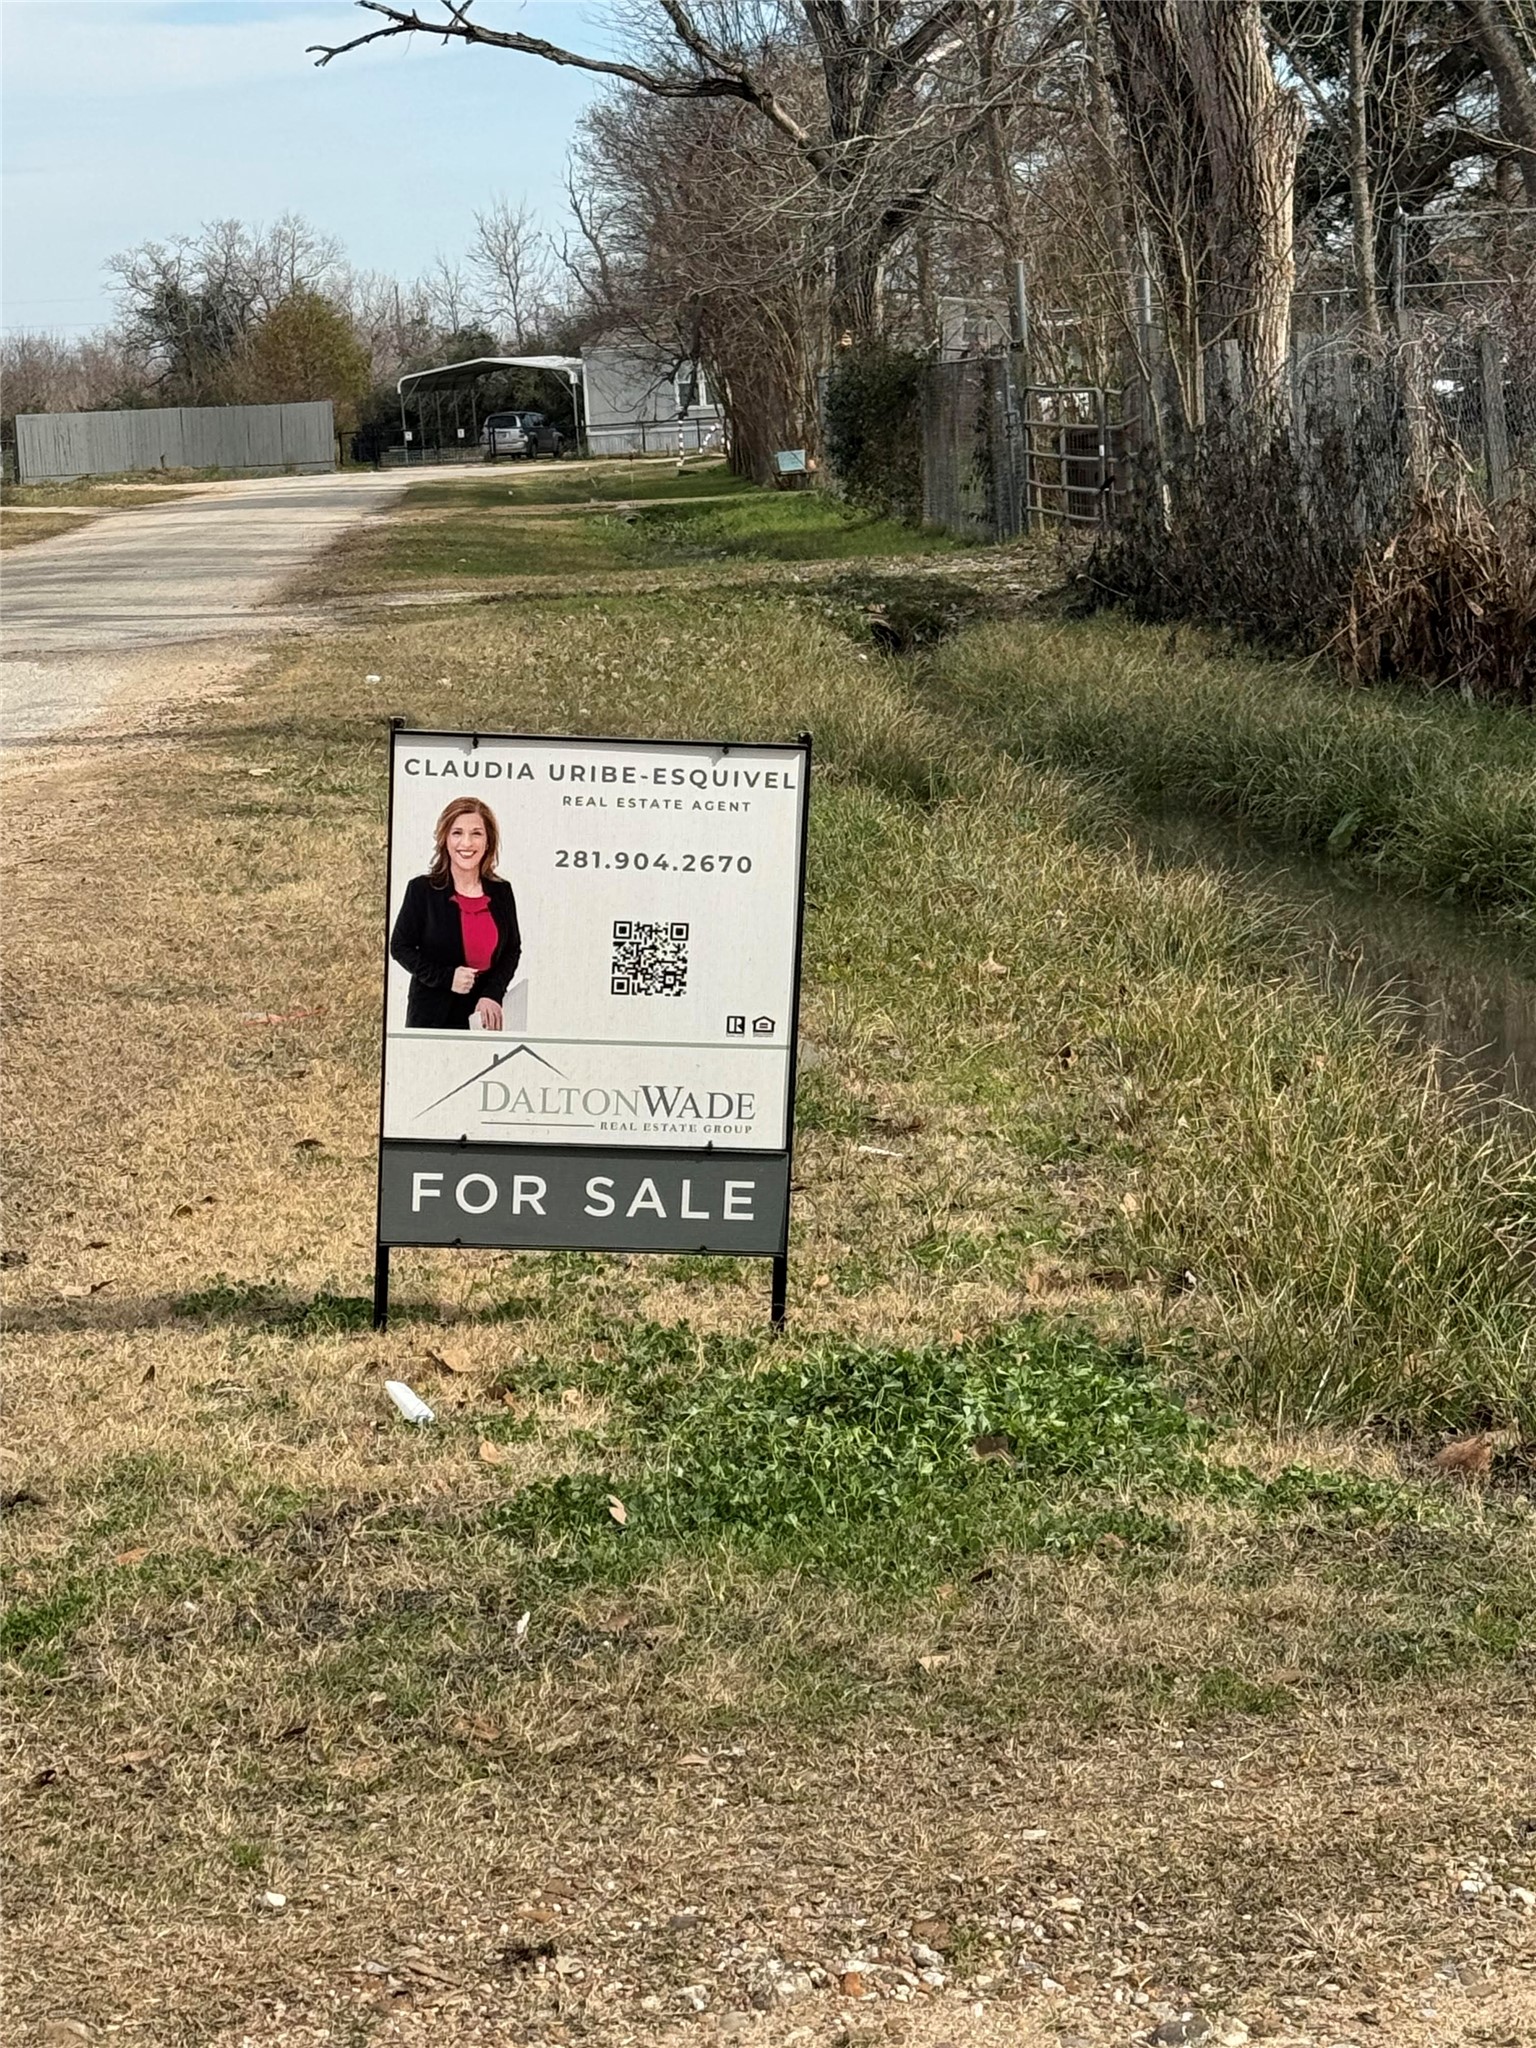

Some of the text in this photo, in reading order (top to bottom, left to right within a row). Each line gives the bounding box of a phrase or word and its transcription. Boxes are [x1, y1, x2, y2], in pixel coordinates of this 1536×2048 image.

[404, 758, 796, 790] CLAUDIA URIBE-ESQUIVEL
[562, 795, 751, 812] REAL ESTATE AGENT
[554, 850, 753, 874] 281.904.2670
[600, 1121, 753, 1134] REAL ESTATE GROUP
[411, 1172, 756, 1221] FOR SALE
